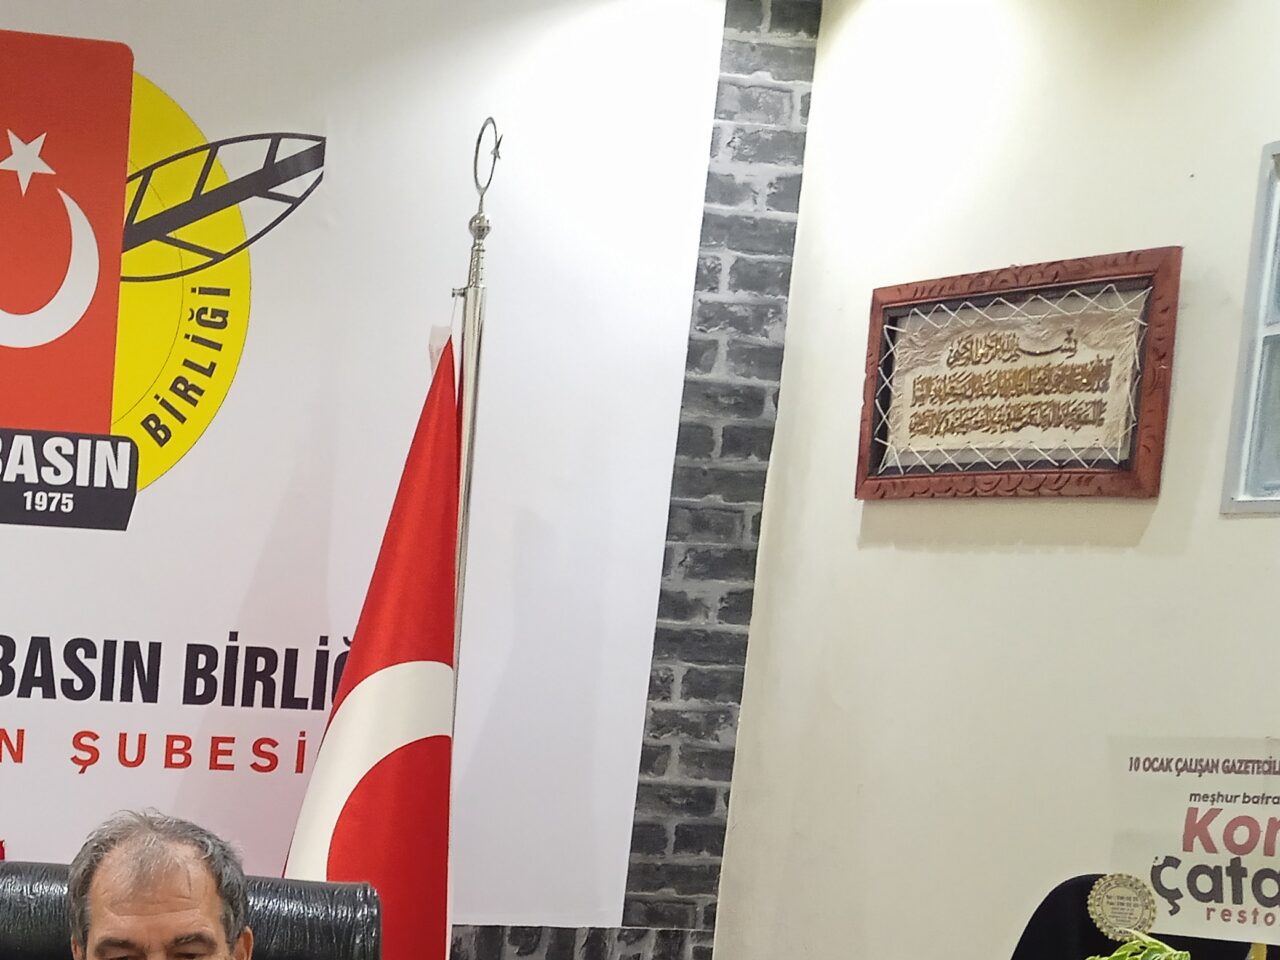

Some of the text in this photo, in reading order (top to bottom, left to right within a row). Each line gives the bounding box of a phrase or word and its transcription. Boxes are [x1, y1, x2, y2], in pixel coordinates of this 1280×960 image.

[141, 285, 232, 448] BİRLİĞİ
[23, 490, 74, 513] 1975
[71, 729, 308, 775] ŞUBESİ
[1128, 756, 1142, 773] 10
[1143, 757, 1174, 773] OCAK
[1175, 757, 1221, 778] ÇALIŞAN
[1188, 791, 1240, 806] meşhur
